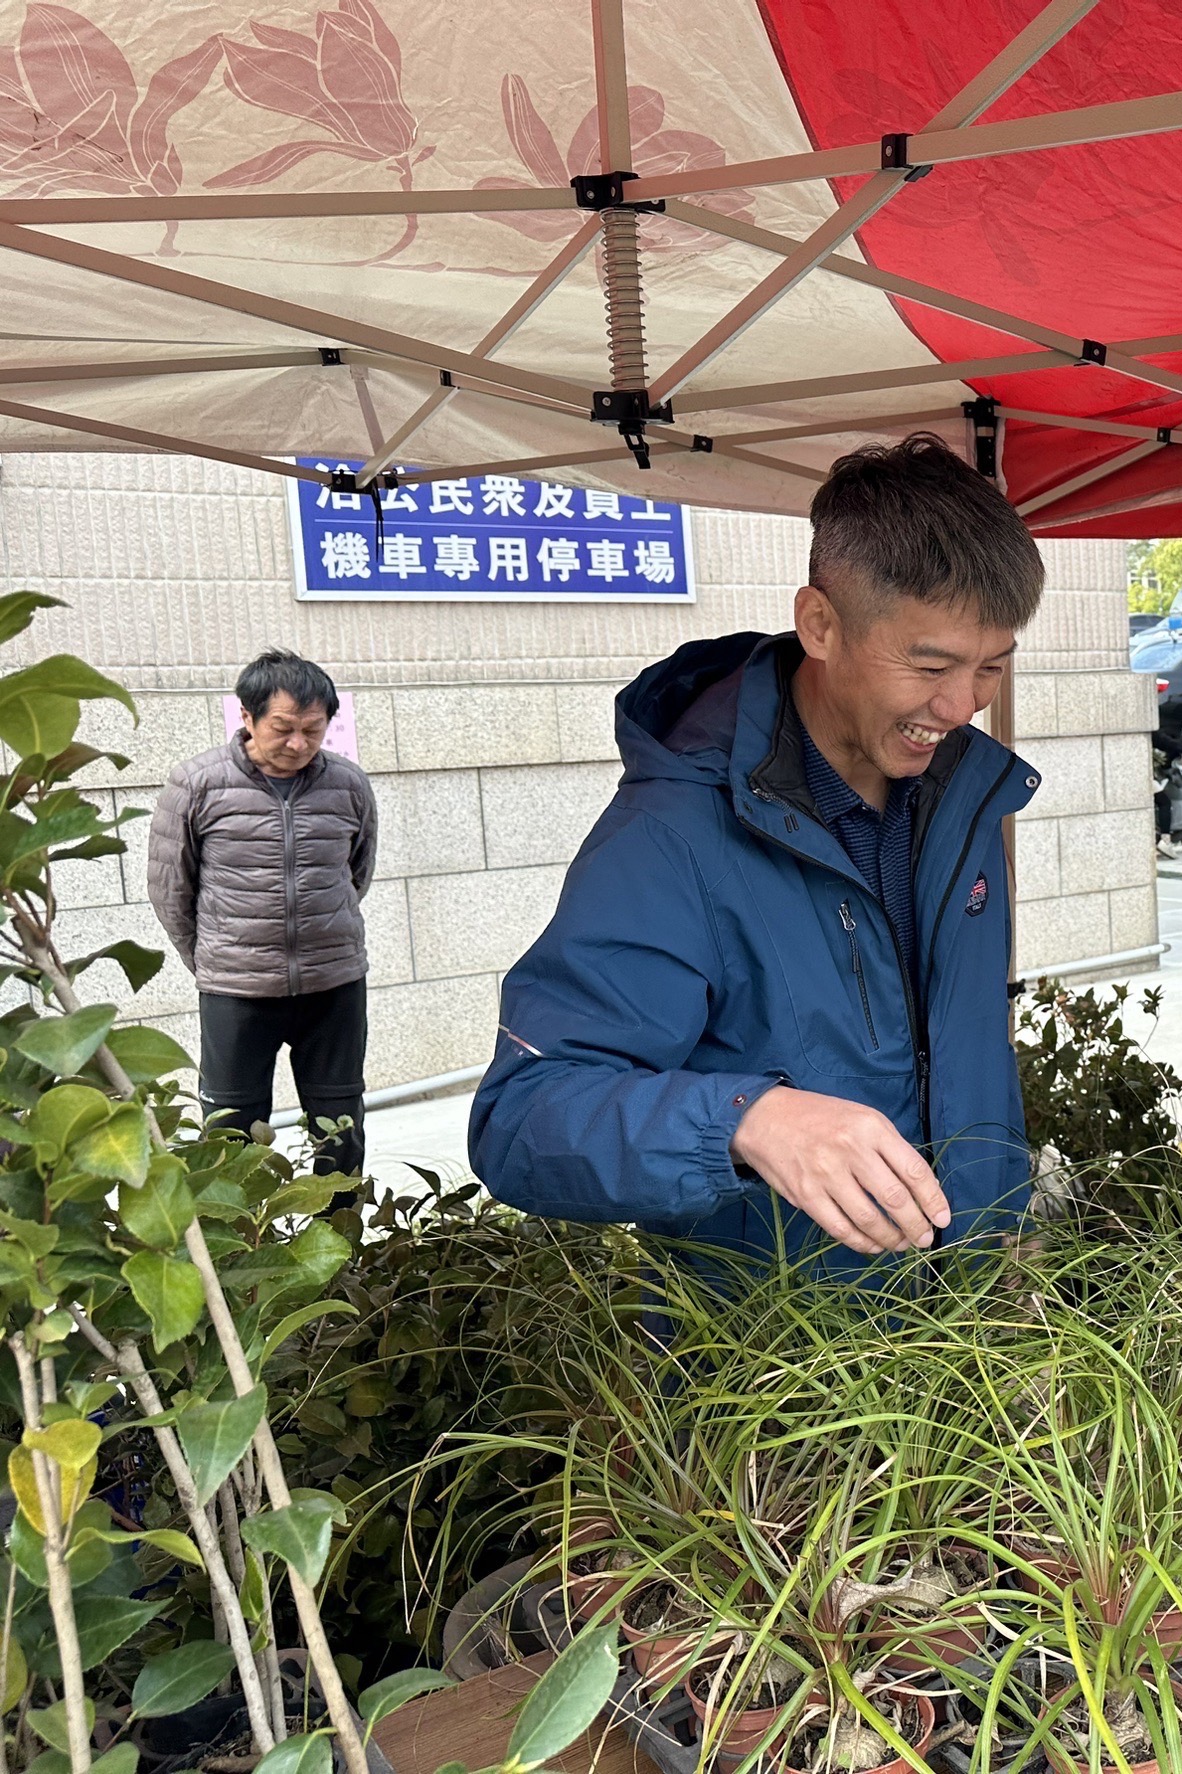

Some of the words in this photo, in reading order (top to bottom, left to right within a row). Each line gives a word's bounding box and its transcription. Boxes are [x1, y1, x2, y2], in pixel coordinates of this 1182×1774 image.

[319, 531, 676, 584] 機車專用停車場
